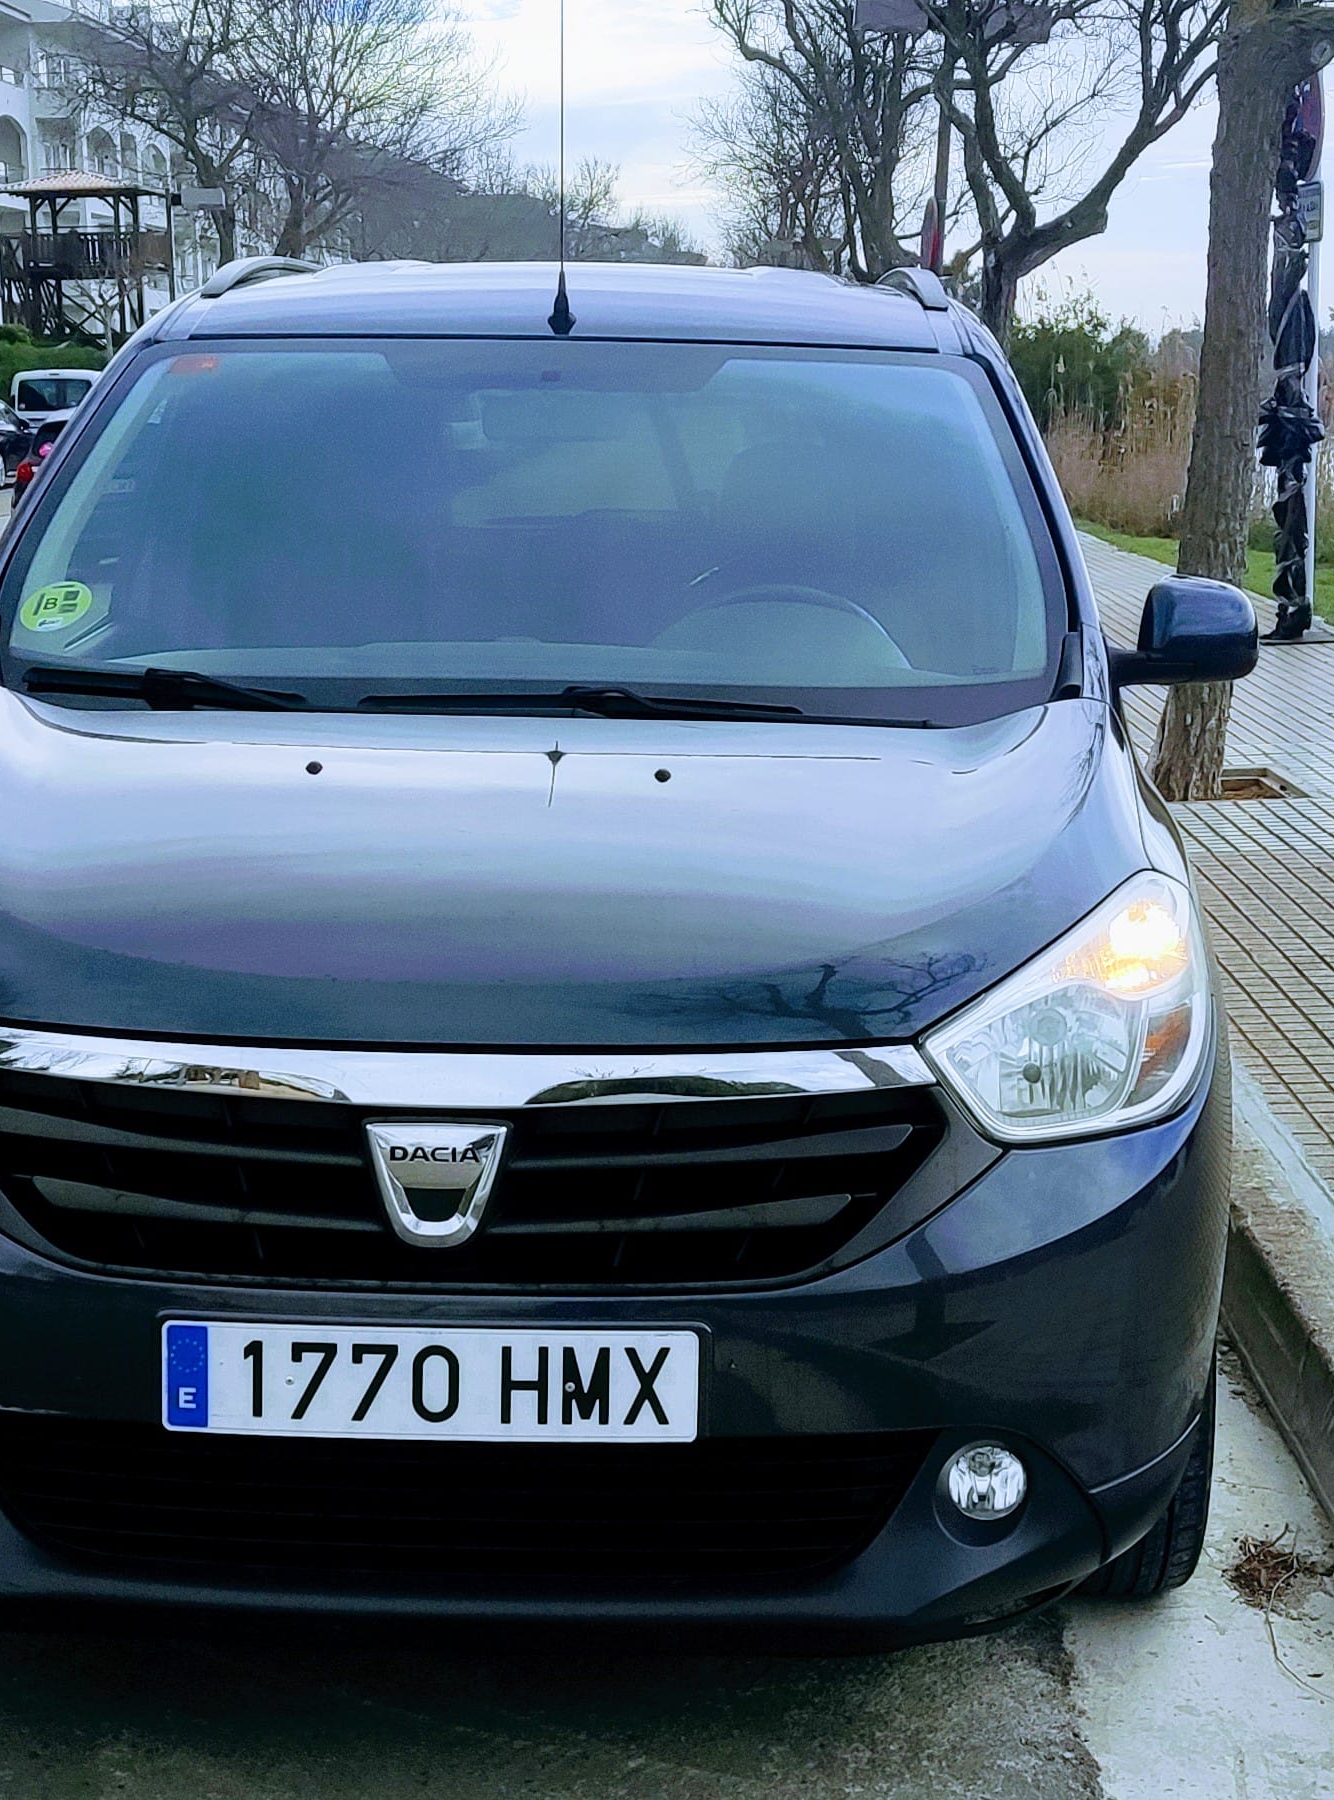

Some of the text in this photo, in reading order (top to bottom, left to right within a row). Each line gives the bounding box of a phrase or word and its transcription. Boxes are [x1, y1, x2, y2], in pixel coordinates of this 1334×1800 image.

[42, 597, 59, 611] B
[389, 1145, 480, 1163] DACIA
[243, 1340, 671, 1426] 1770 HMX
[178, 1386, 197, 1409] E
